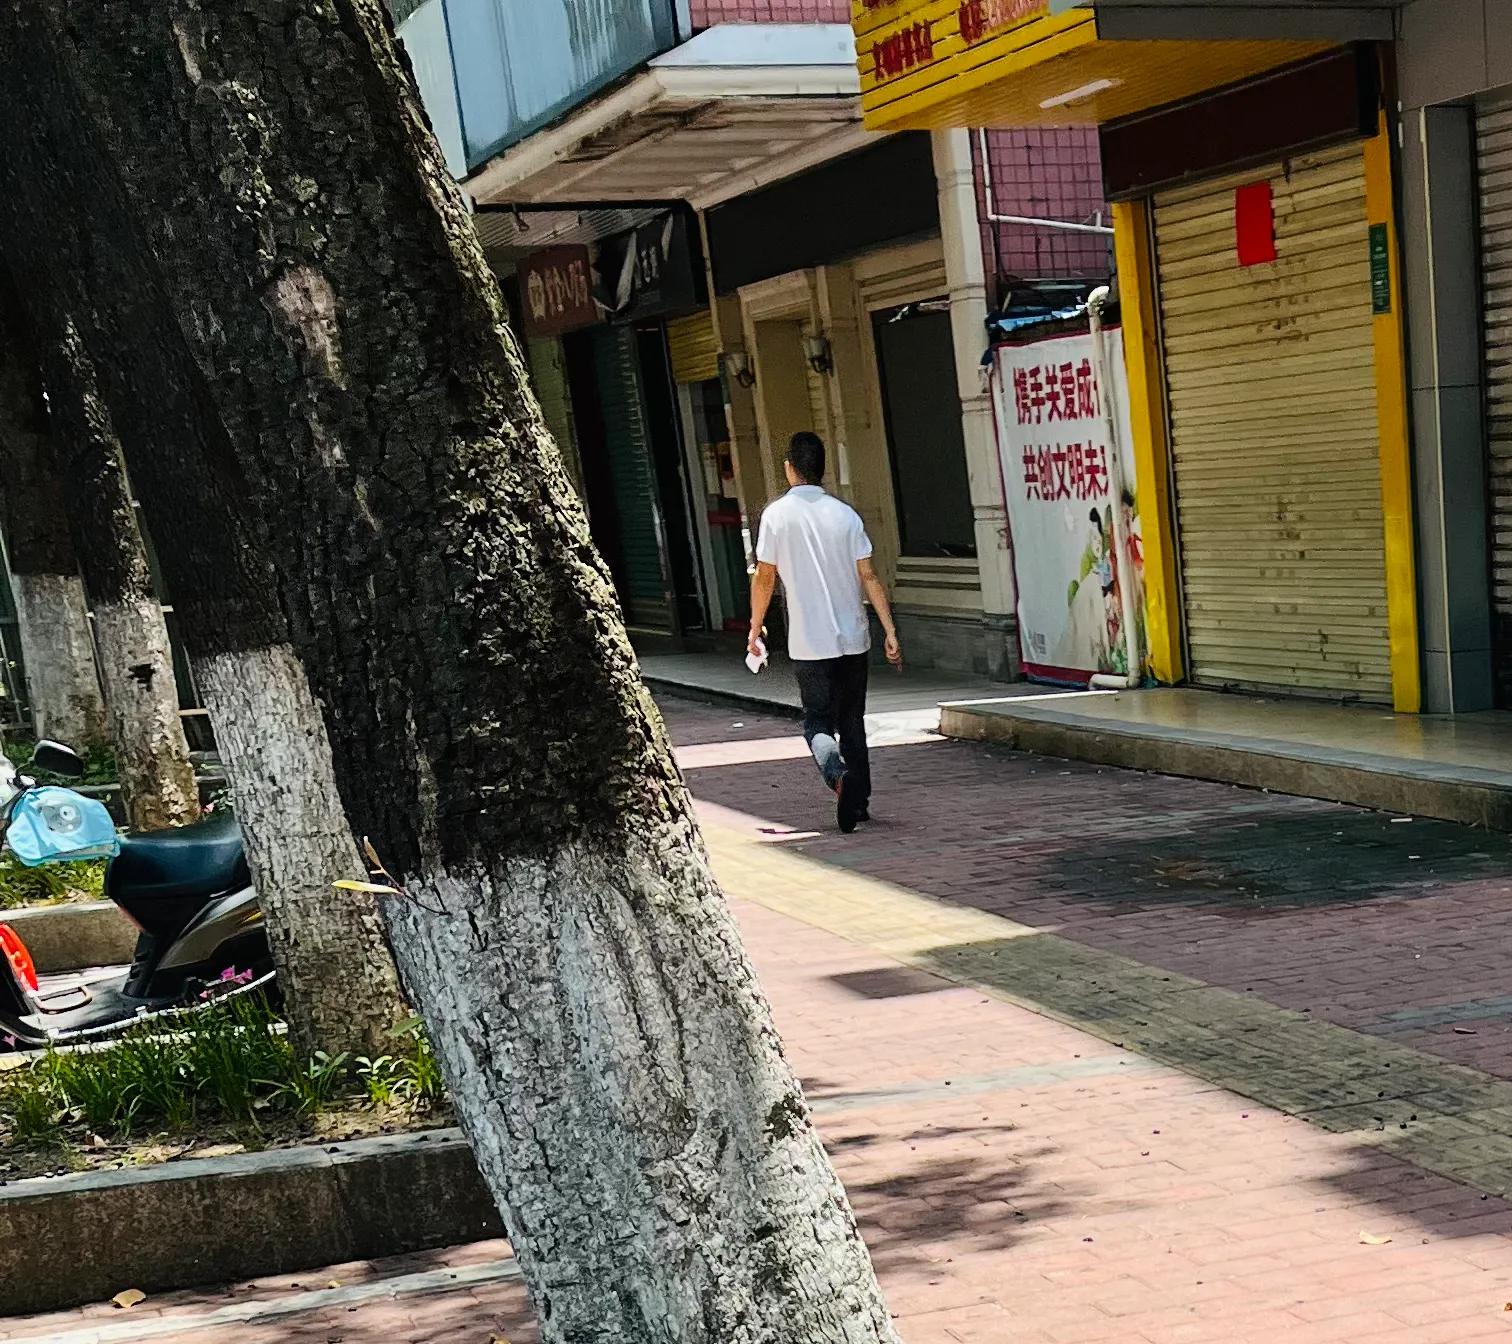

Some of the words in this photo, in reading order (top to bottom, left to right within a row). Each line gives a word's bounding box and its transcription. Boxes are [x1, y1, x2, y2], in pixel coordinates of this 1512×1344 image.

[1012, 357, 1102, 425] 携手关爱成
